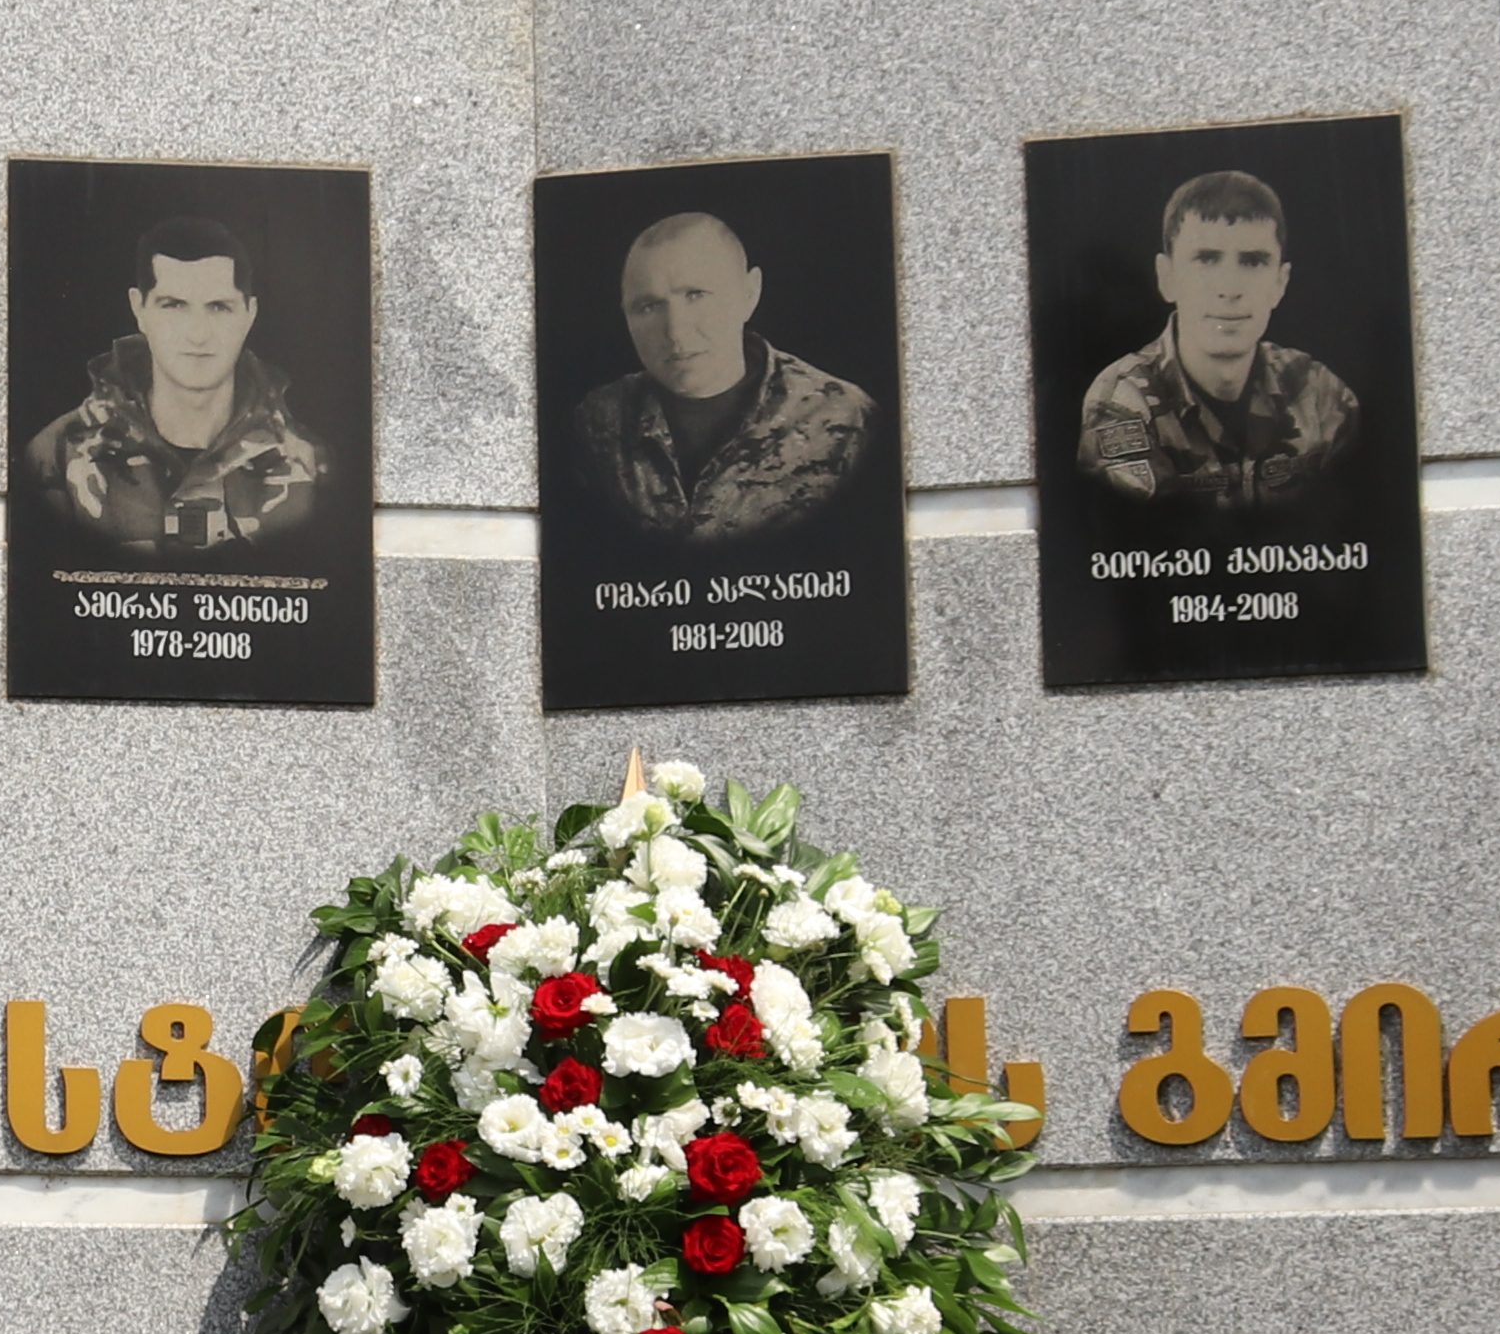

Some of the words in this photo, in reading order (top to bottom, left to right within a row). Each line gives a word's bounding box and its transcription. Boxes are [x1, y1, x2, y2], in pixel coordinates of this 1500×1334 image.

[1091, 548, 1211, 579] გიორგი
[1227, 542, 1368, 574] ქათამაძე
[595, 579, 691, 610] ომარი
[707, 570, 851, 604] ასლანიძე
[74, 590, 178, 620] ამირან
[193, 593, 309, 624] შაინიძე
[1170, 592, 1299, 623] 1984-2008
[130, 628, 252, 660] 1978-2008
[670, 620, 784, 652] 1981-2008
